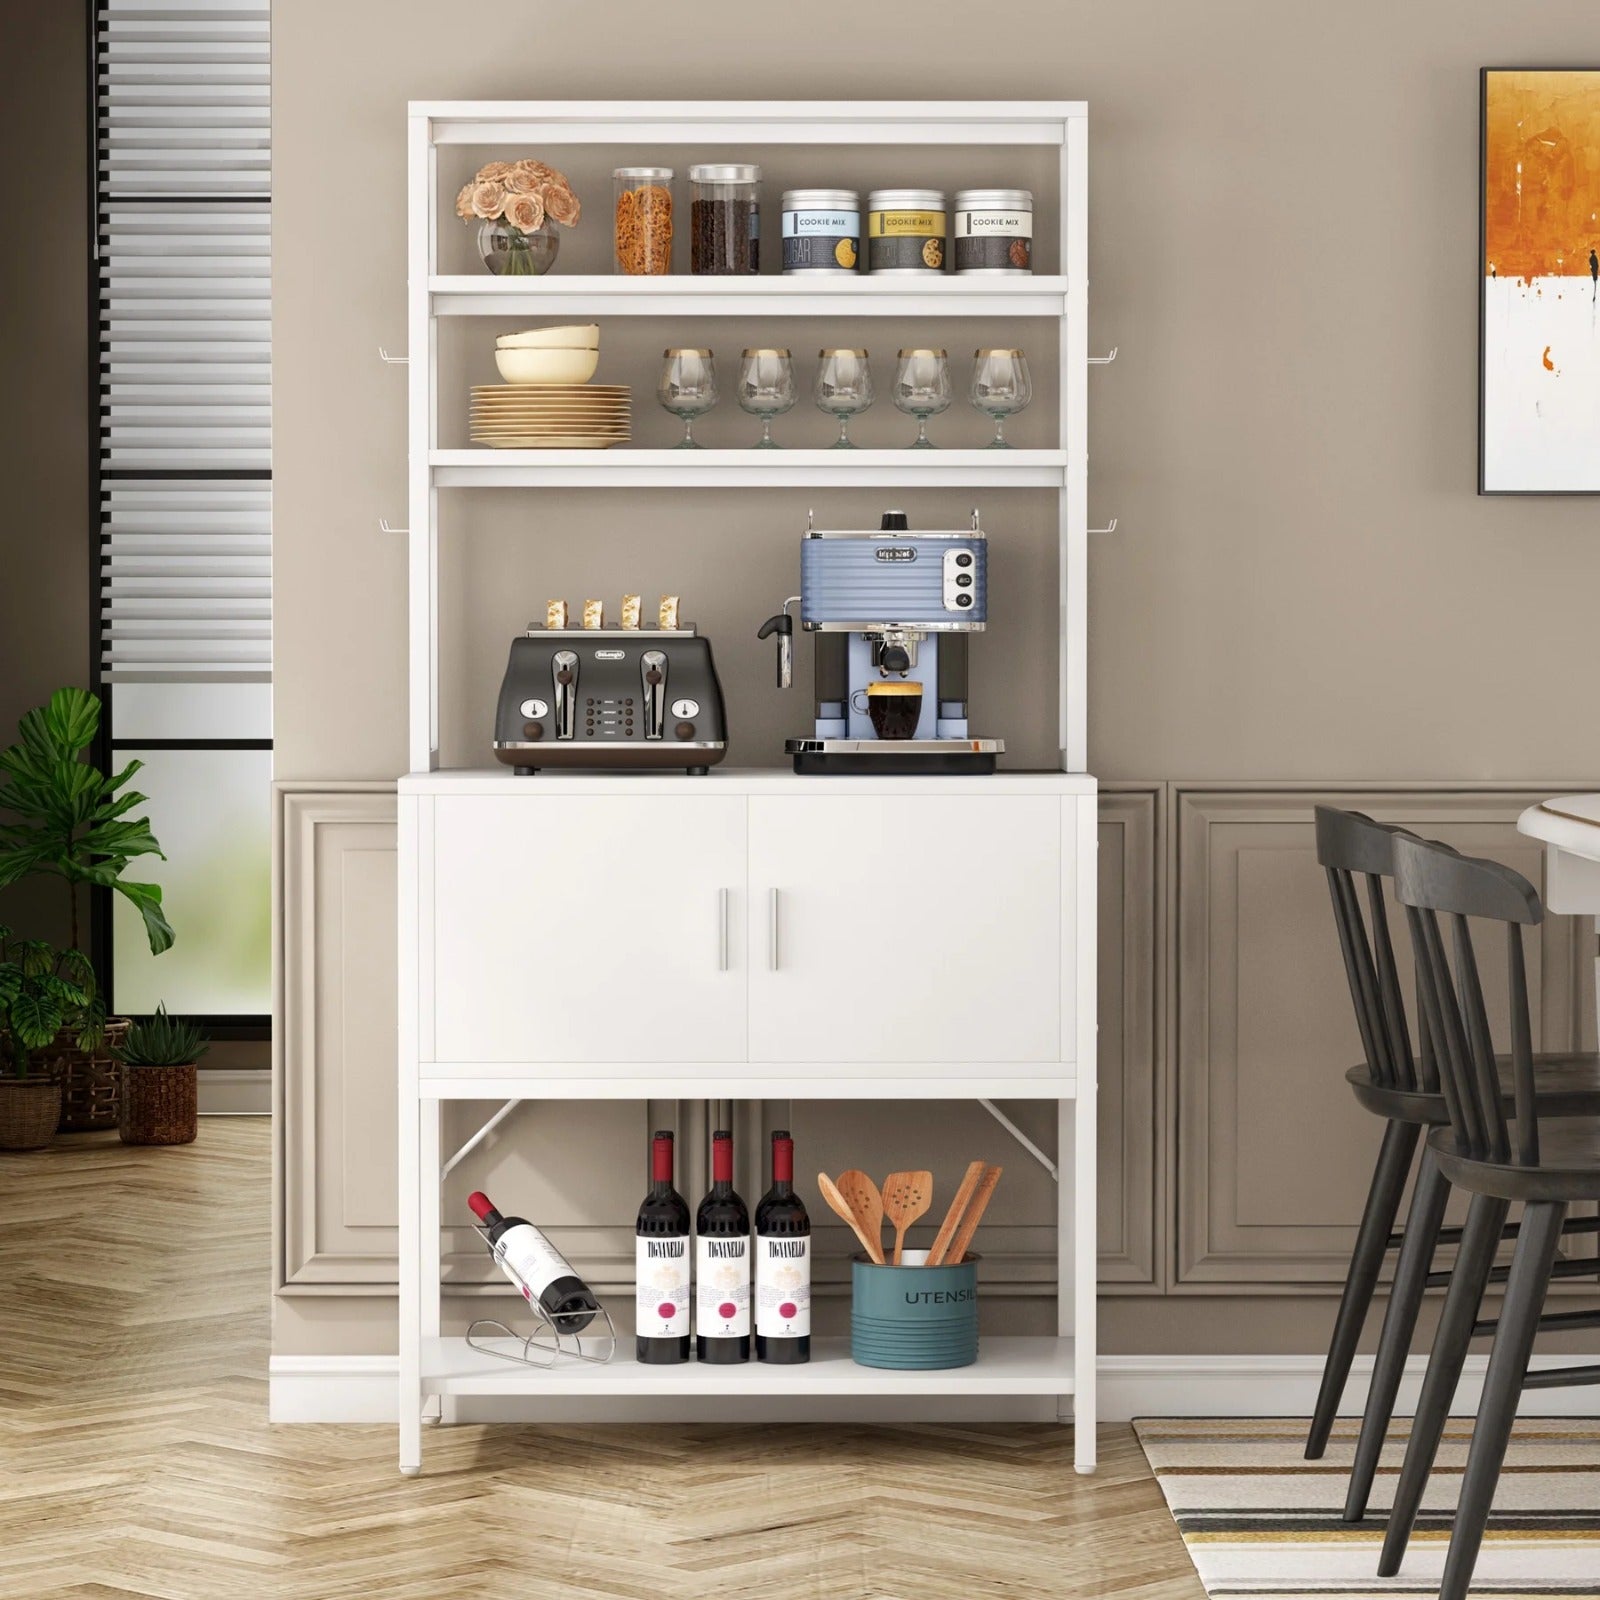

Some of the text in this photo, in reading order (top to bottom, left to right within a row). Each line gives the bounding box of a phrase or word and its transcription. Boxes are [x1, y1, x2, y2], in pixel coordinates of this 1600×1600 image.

[799, 218, 846, 226] COOKIE MIX
[886, 218, 933, 226] COOKIE MIX
[972, 218, 1019, 226] COOKIE MIX
